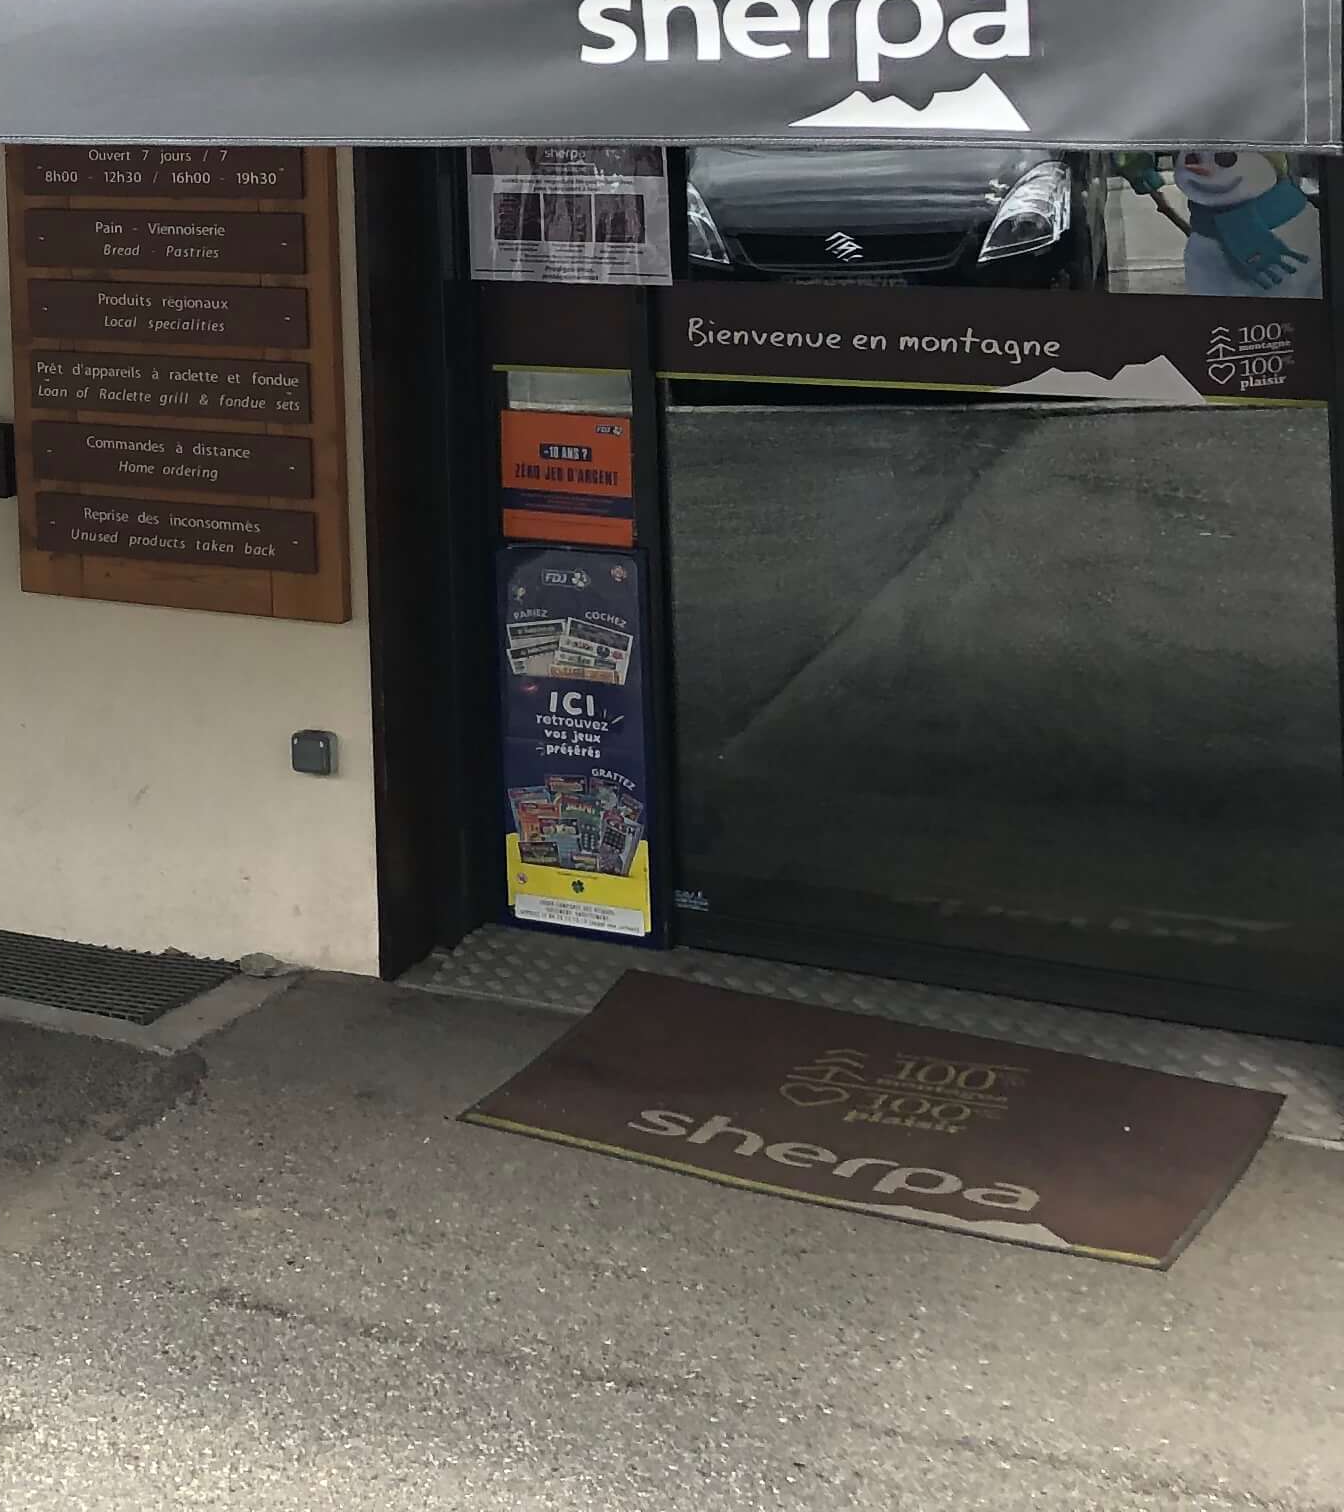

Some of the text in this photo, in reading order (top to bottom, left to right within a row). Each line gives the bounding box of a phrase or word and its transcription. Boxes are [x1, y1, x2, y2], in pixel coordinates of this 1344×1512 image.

[89, 149, 130, 162] Ouvert
[142, 149, 149, 161] 7
[160, 149, 192, 165] jours
[220, 149, 227, 161] 7
[45, 170, 78, 183] 8h00
[104, 171, 142, 184] 12h30
[171, 172, 211, 185] 16h00
[236, 172, 277, 185] 19h30
[95, 221, 123, 234] Pain
[148, 222, 225, 237] Viennoiserie
[103, 244, 140, 256] Bread
[166, 245, 219, 258] Pastries
[98, 293, 152, 308] Produits
[104, 316, 225, 332] Local specialities
[688, 317, 1061, 364] Bienvenue en montagne
[37, 361, 299, 388] Prêt d'appareils à raclette et fondue
[1240, 374, 1287, 391] plaisir
[38, 385, 300, 411] Loan of Raclette grill & fondue sets
[86, 436, 251, 459] Commandes à distance
[562, 447, 579, 460] ANS
[118, 461, 219, 482] Home ordering
[83, 507, 261, 533] Reprise des inconsommés
[71, 528, 277, 557] Unused products taken back
[545, 572, 568, 584] FDJ
[513, 608, 548, 620] PARIEZ
[585, 611, 627, 628] COCHEZ
[549, 691, 595, 716] ICI
[536, 714, 608, 731] retrouvez
[544, 729, 600, 743] vos jeux
[546, 743, 601, 759] préférés
[592, 768, 636, 791] GRATTEZ
[627, 1109, 1041, 1212] sherpa
